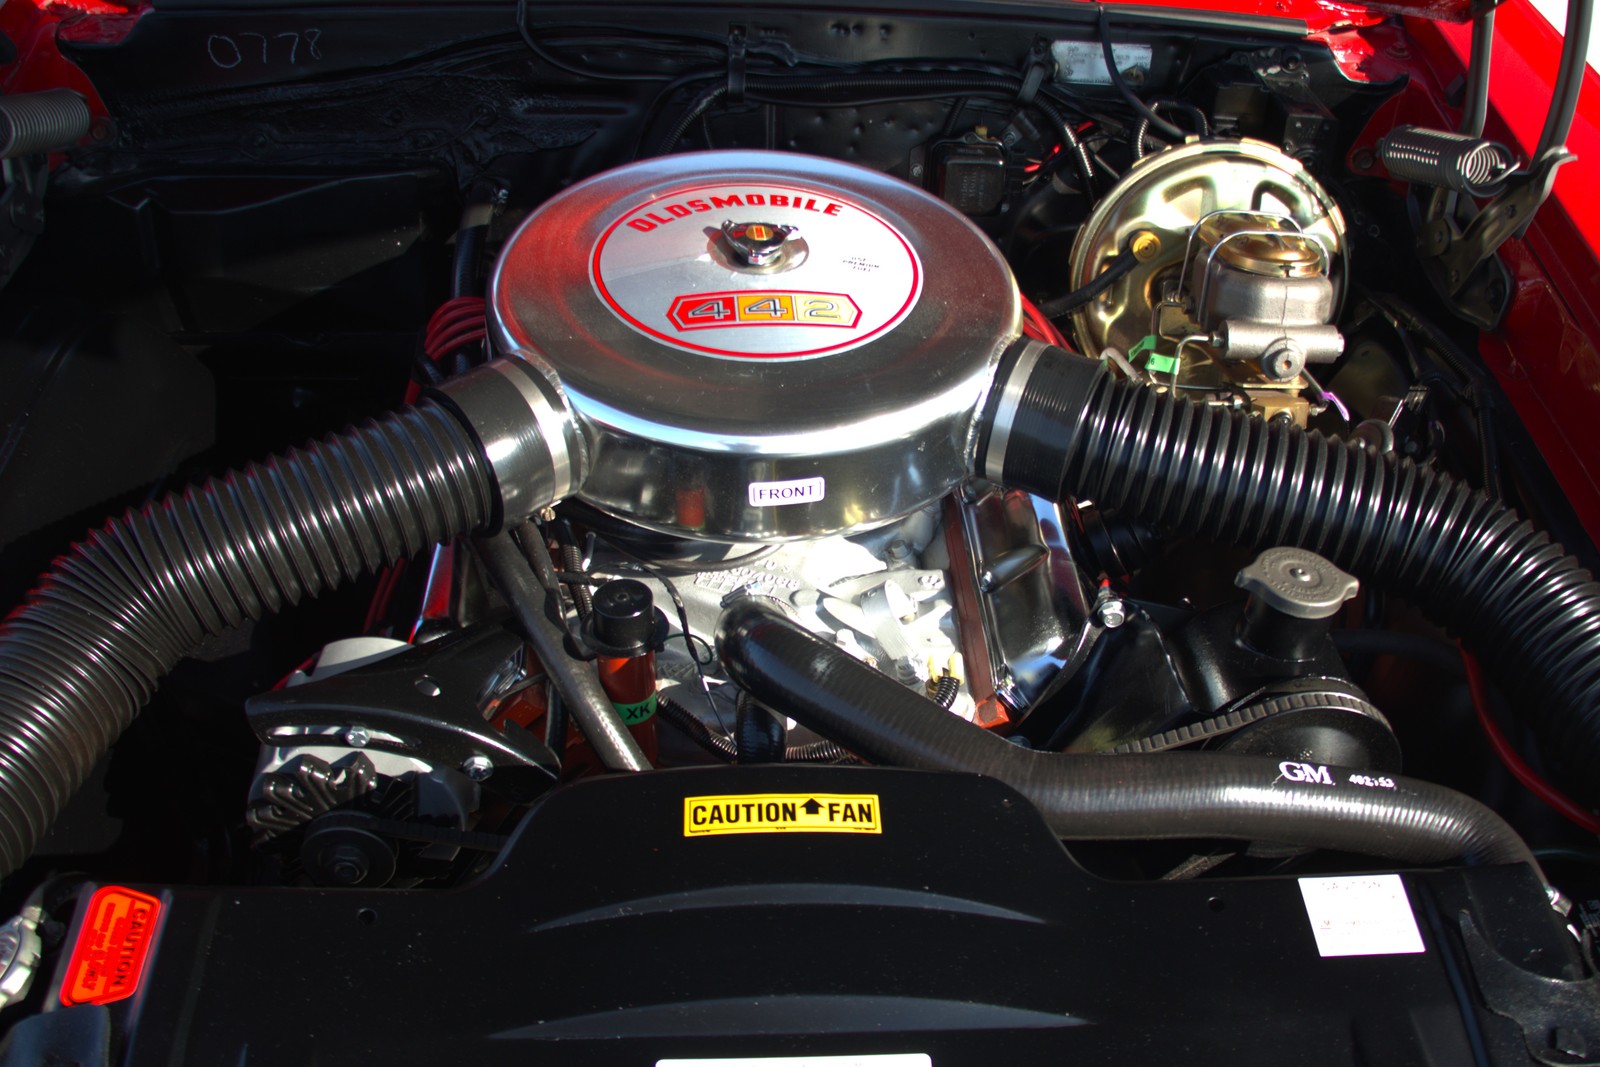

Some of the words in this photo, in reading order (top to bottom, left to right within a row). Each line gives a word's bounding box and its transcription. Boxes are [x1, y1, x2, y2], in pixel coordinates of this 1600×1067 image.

[207, 28, 322, 69] 0778
[626, 193, 843, 233] OLDSMOBILE
[759, 485, 815, 500] FRONT
[626, 703, 650, 720] XK
[1278, 761, 1334, 785] GM
[692, 803, 797, 826] CAUTION
[828, 803, 873, 823] FAN
[112, 908, 148, 986] CAUTION
